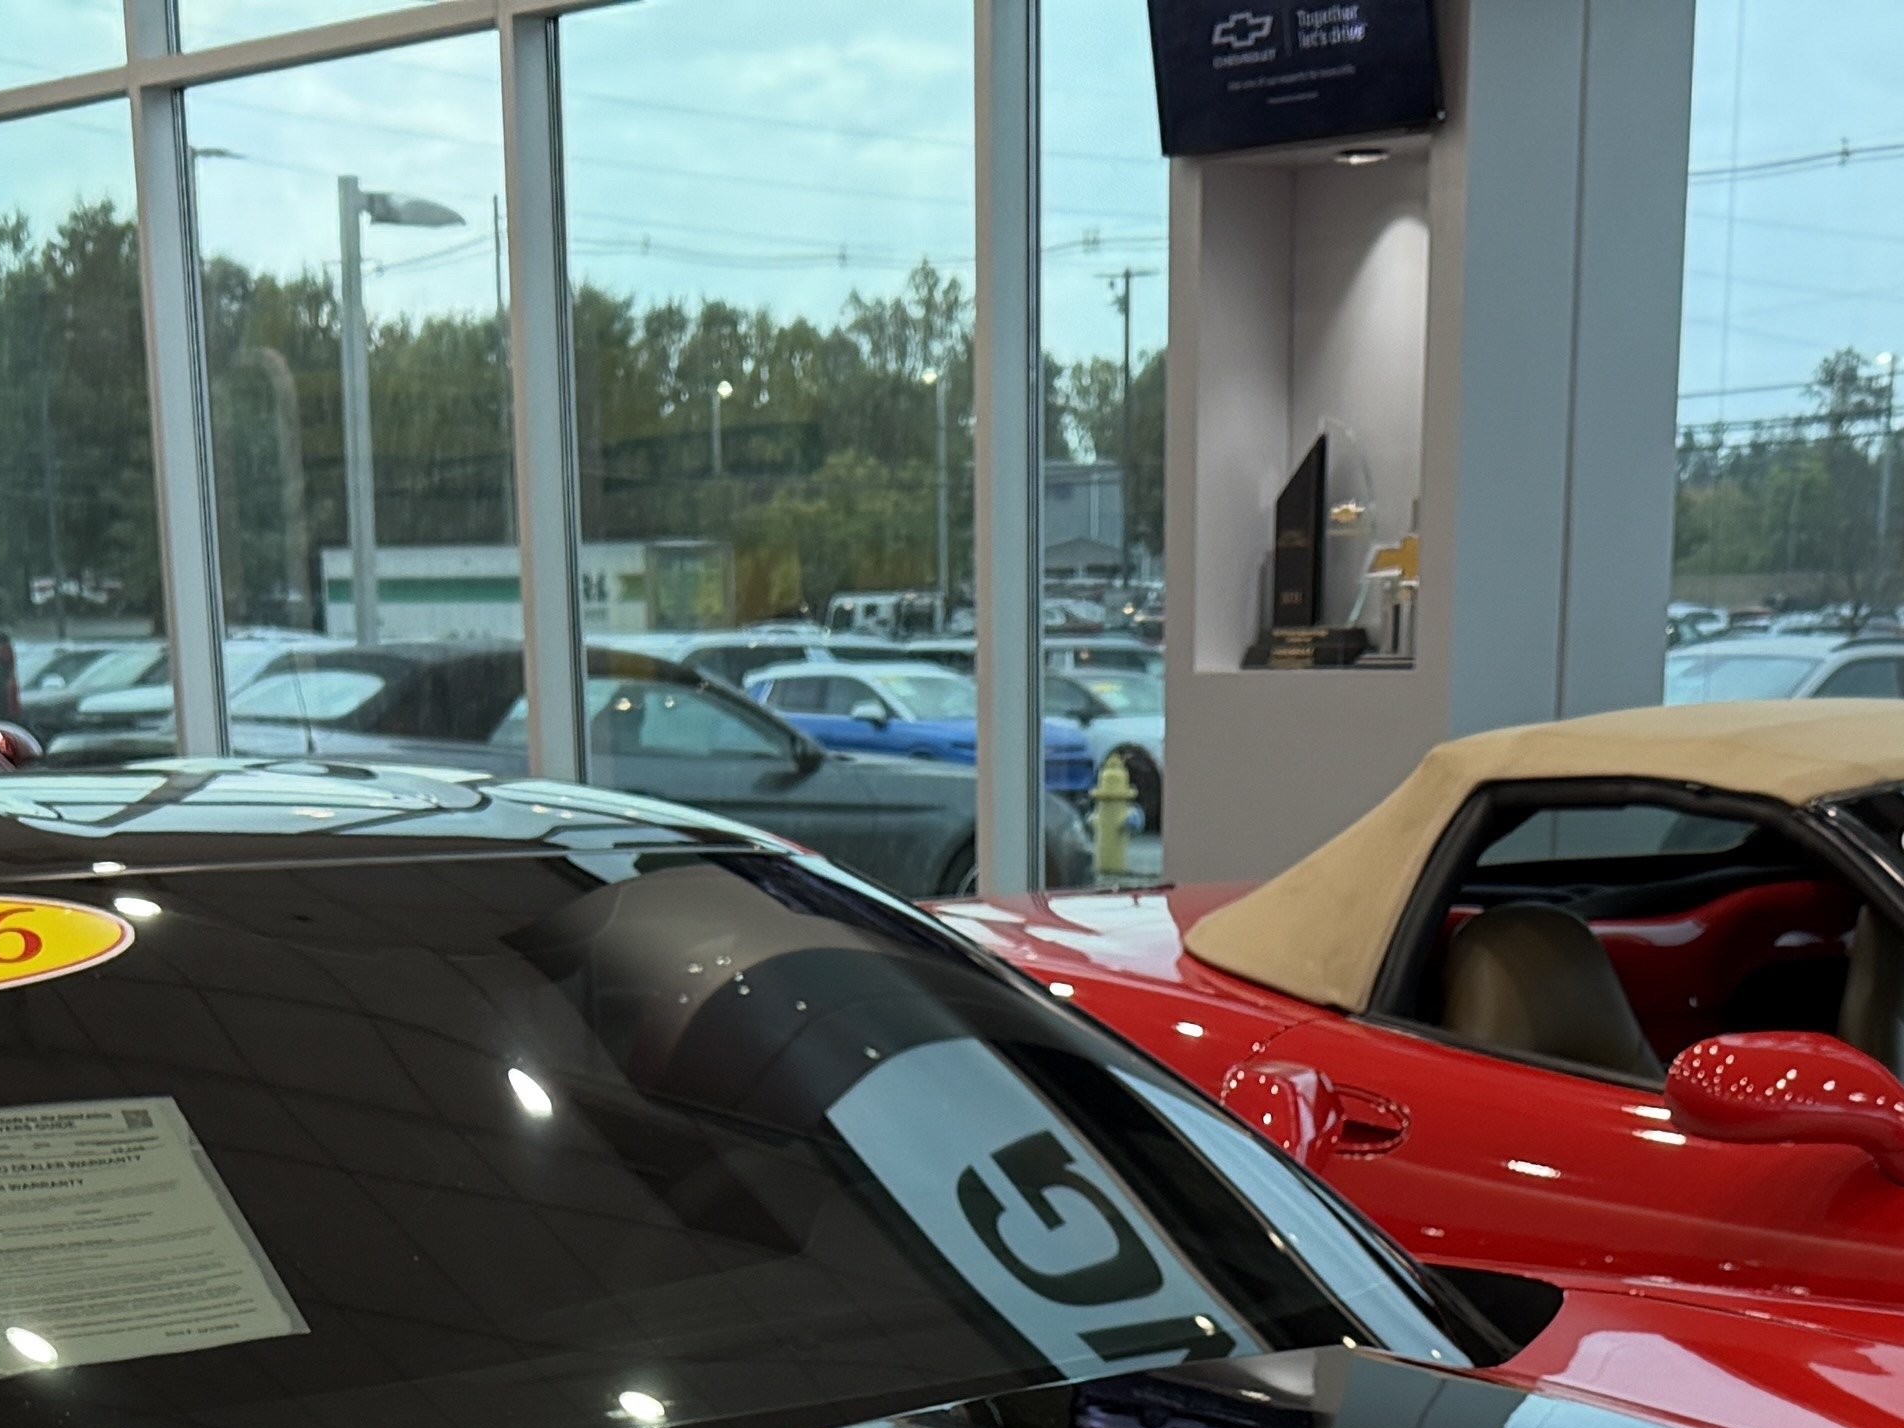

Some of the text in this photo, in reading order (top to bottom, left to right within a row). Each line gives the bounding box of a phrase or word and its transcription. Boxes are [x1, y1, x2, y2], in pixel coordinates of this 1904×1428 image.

[1296, 5, 1359, 28] Together
[11, 1161, 65, 1172] DEALER
[67, 1153, 142, 1169] WARRANTY
[8, 1179, 84, 1192] WARRANTY
